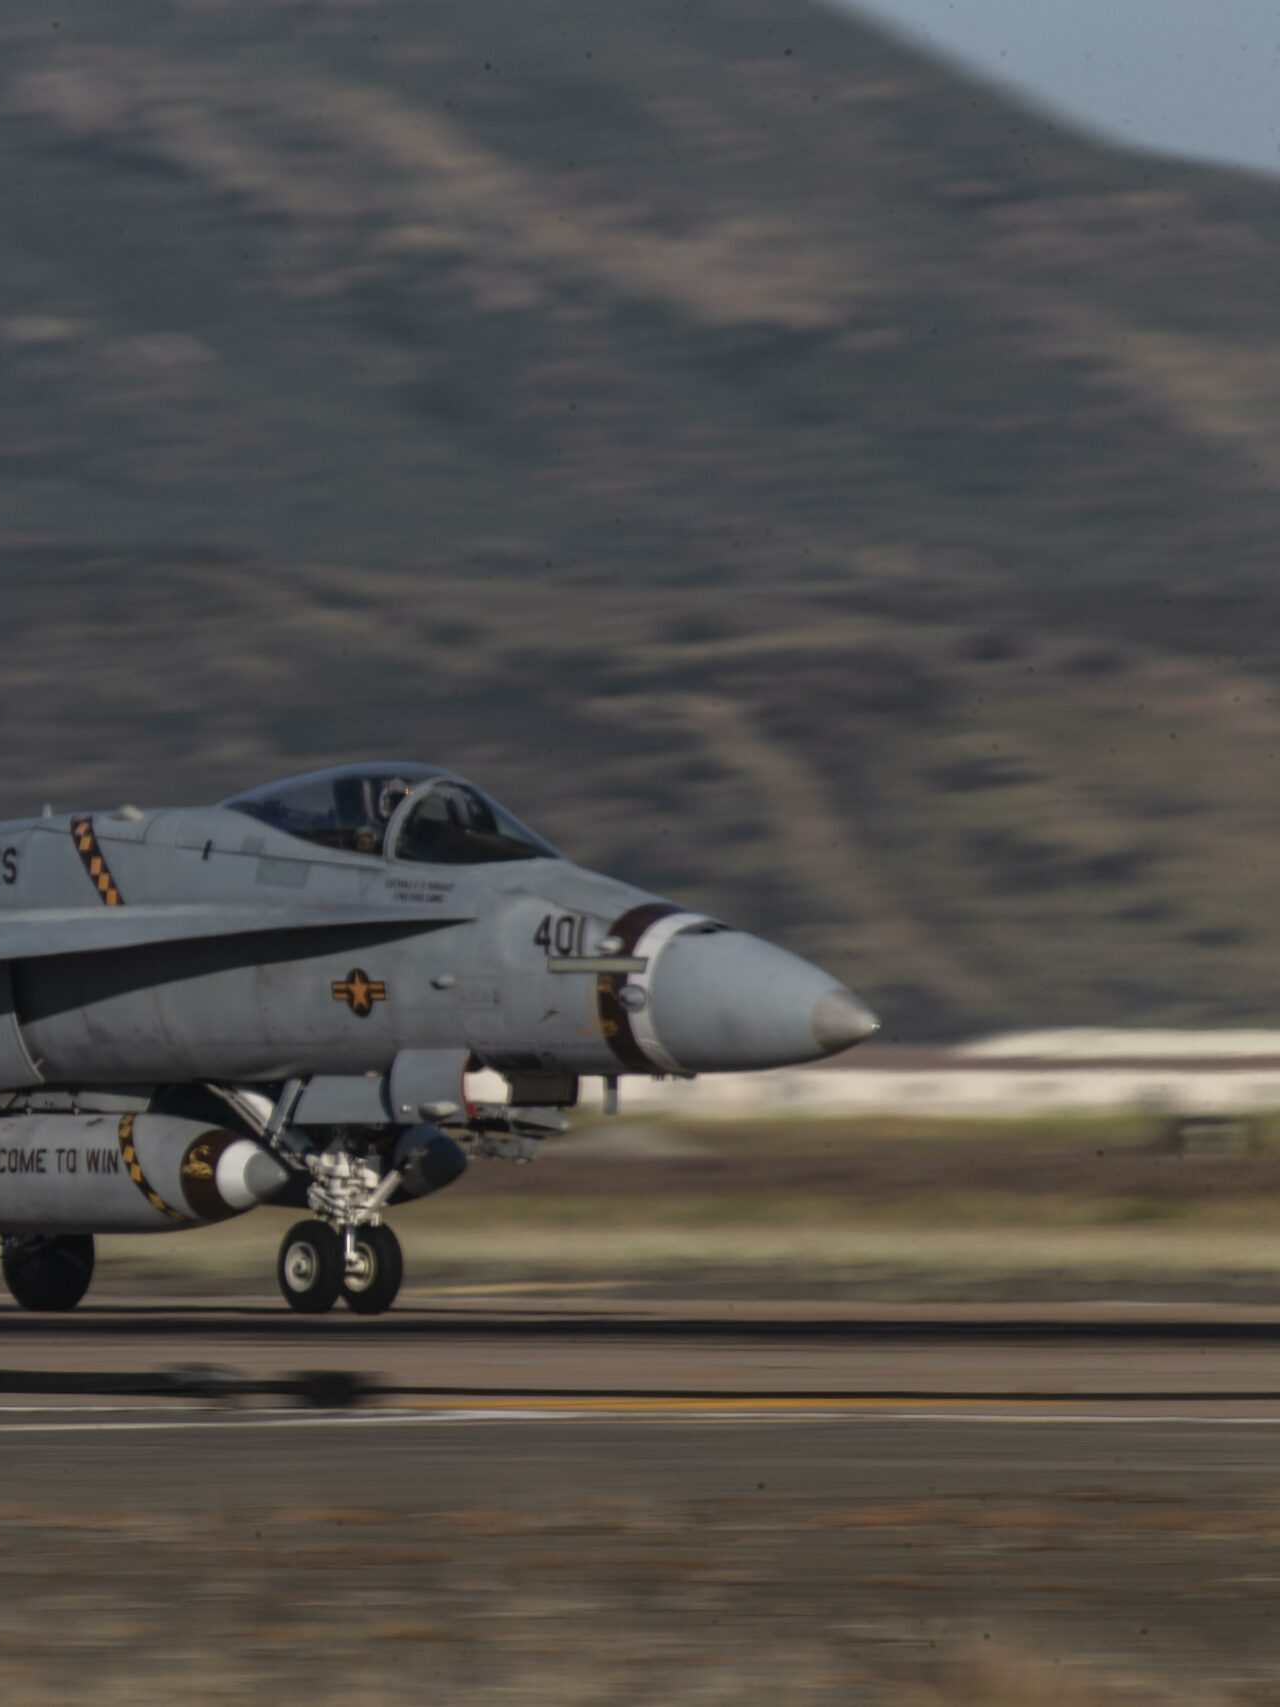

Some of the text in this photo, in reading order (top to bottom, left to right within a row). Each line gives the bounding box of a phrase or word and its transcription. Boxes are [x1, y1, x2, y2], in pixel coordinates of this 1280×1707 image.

[533, 914, 586, 956] 401
[56, 1148, 77, 1174] TO
[87, 1148, 119, 1174] WIN
